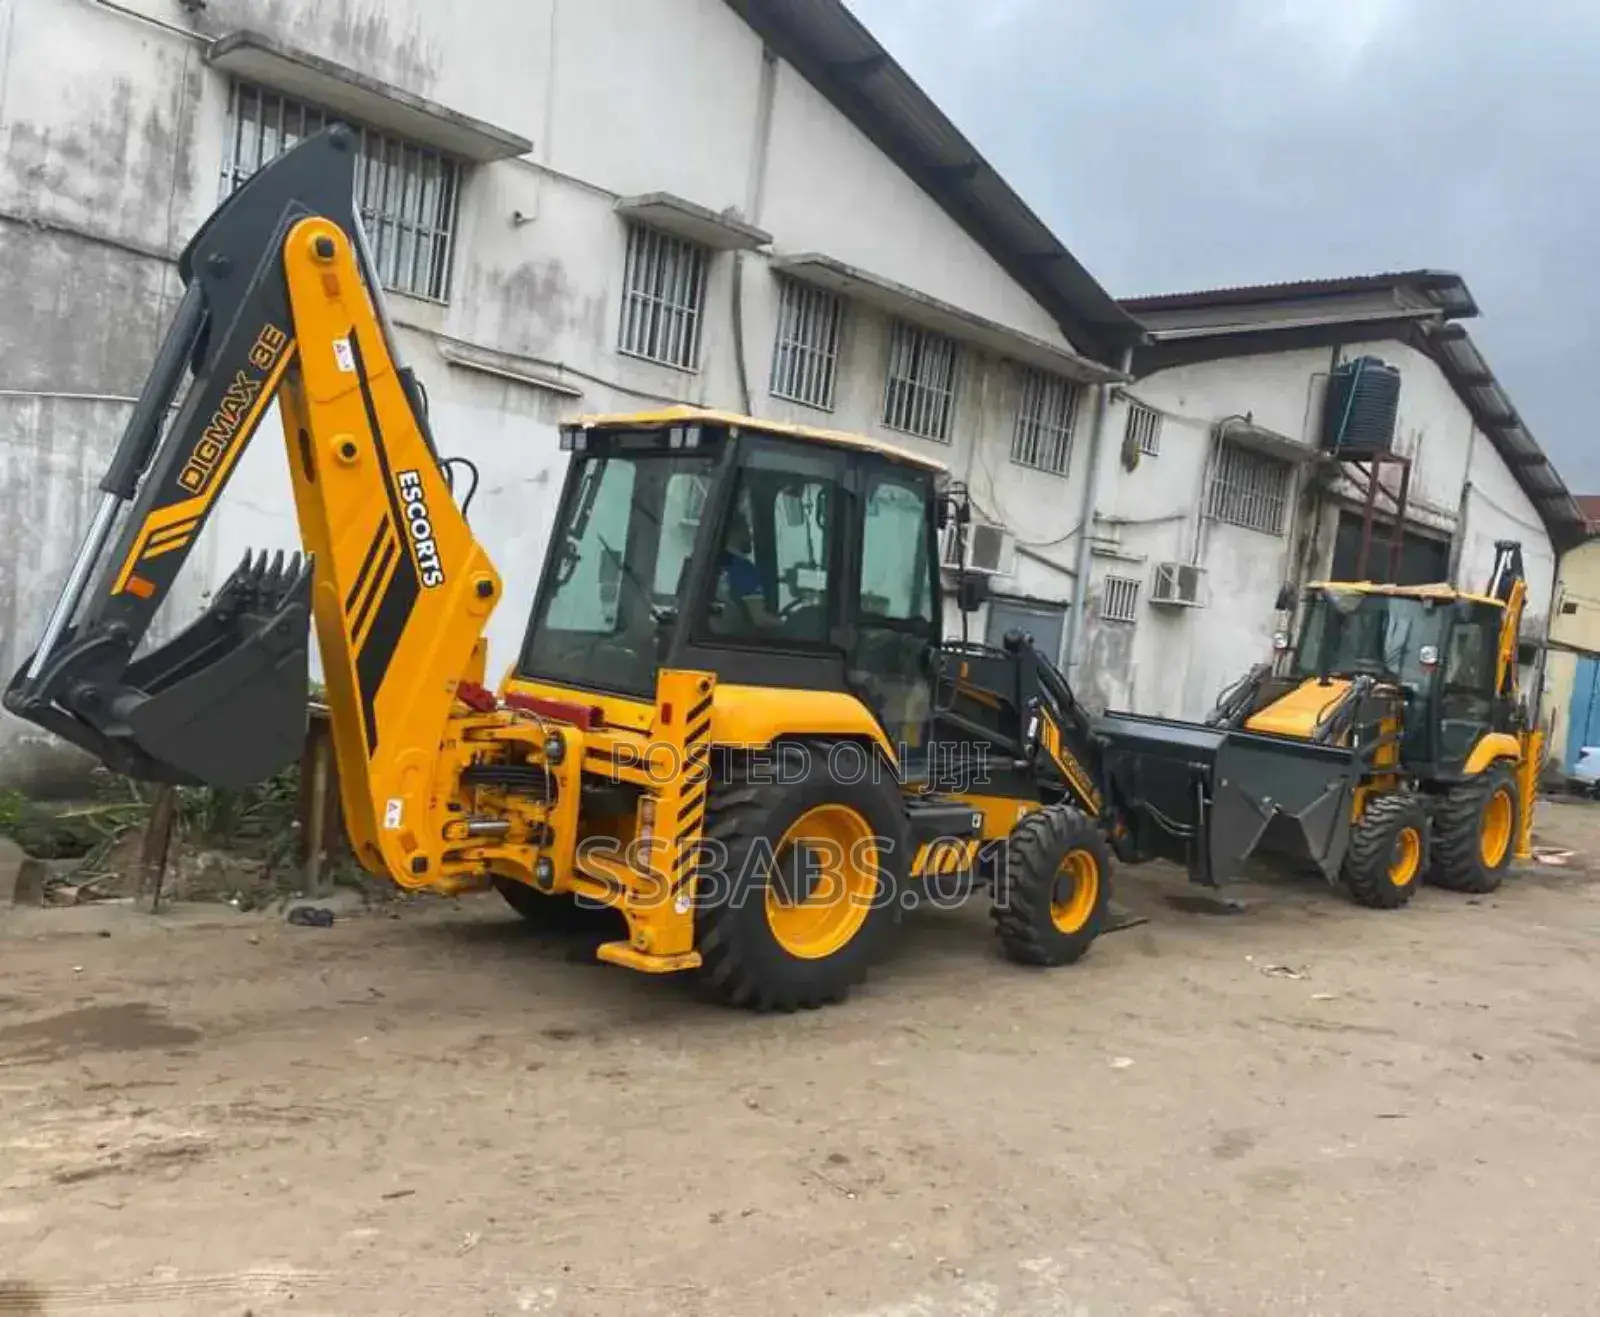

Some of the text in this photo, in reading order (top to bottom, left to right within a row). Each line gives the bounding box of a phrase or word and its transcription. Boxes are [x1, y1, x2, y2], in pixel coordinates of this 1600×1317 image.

[177, 324, 286, 494] DIGMAX 3E
[397, 469, 443, 589] ESCORTS
